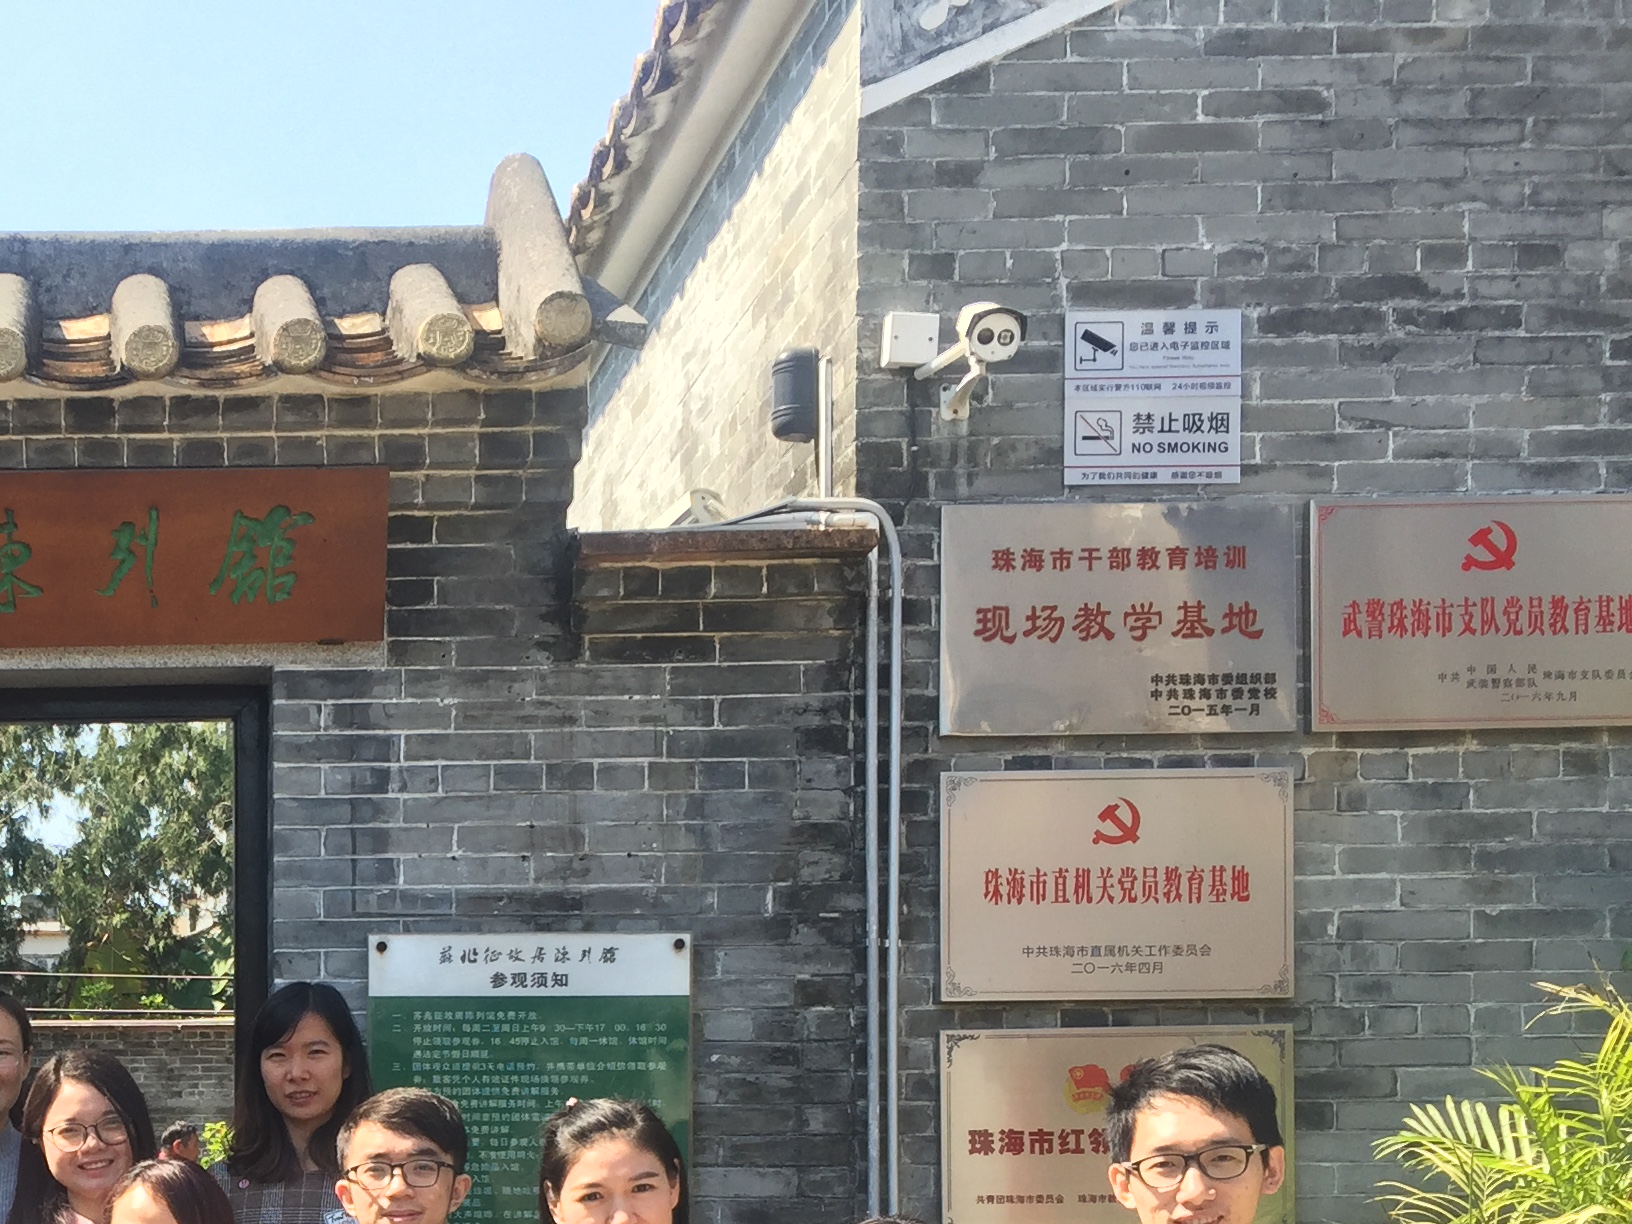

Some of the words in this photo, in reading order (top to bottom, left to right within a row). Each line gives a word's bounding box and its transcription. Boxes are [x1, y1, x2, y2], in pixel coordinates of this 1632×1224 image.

[1141, 321, 1218, 335] 温馨提示
[1129, 341, 1231, 351] 您已进入电子监控区域
[1132, 412, 1229, 434] 禁止吸烟
[1132, 442, 1153, 454] NO
[1157, 441, 1229, 454] SMOKING
[992, 545, 1247, 573] 珠海市干部教育培训
[973, 600, 1265, 644] 现场教学基地
[1341, 594, 1632, 639] 武警珠海市支队党员教育基地
[1150, 672, 1277, 687] 中共珠海市委组织部
[1150, 687, 1278, 701] 中共珠海市委党校
[983, 865, 1251, 906] 珠海市直机关党员教育基地
[1022, 944, 1212, 958] 中共珠海市直属机关工作委员会
[489, 972, 569, 989] 参观须知
[976, 1194, 1064, 1204] 共青团珠海市委员会
